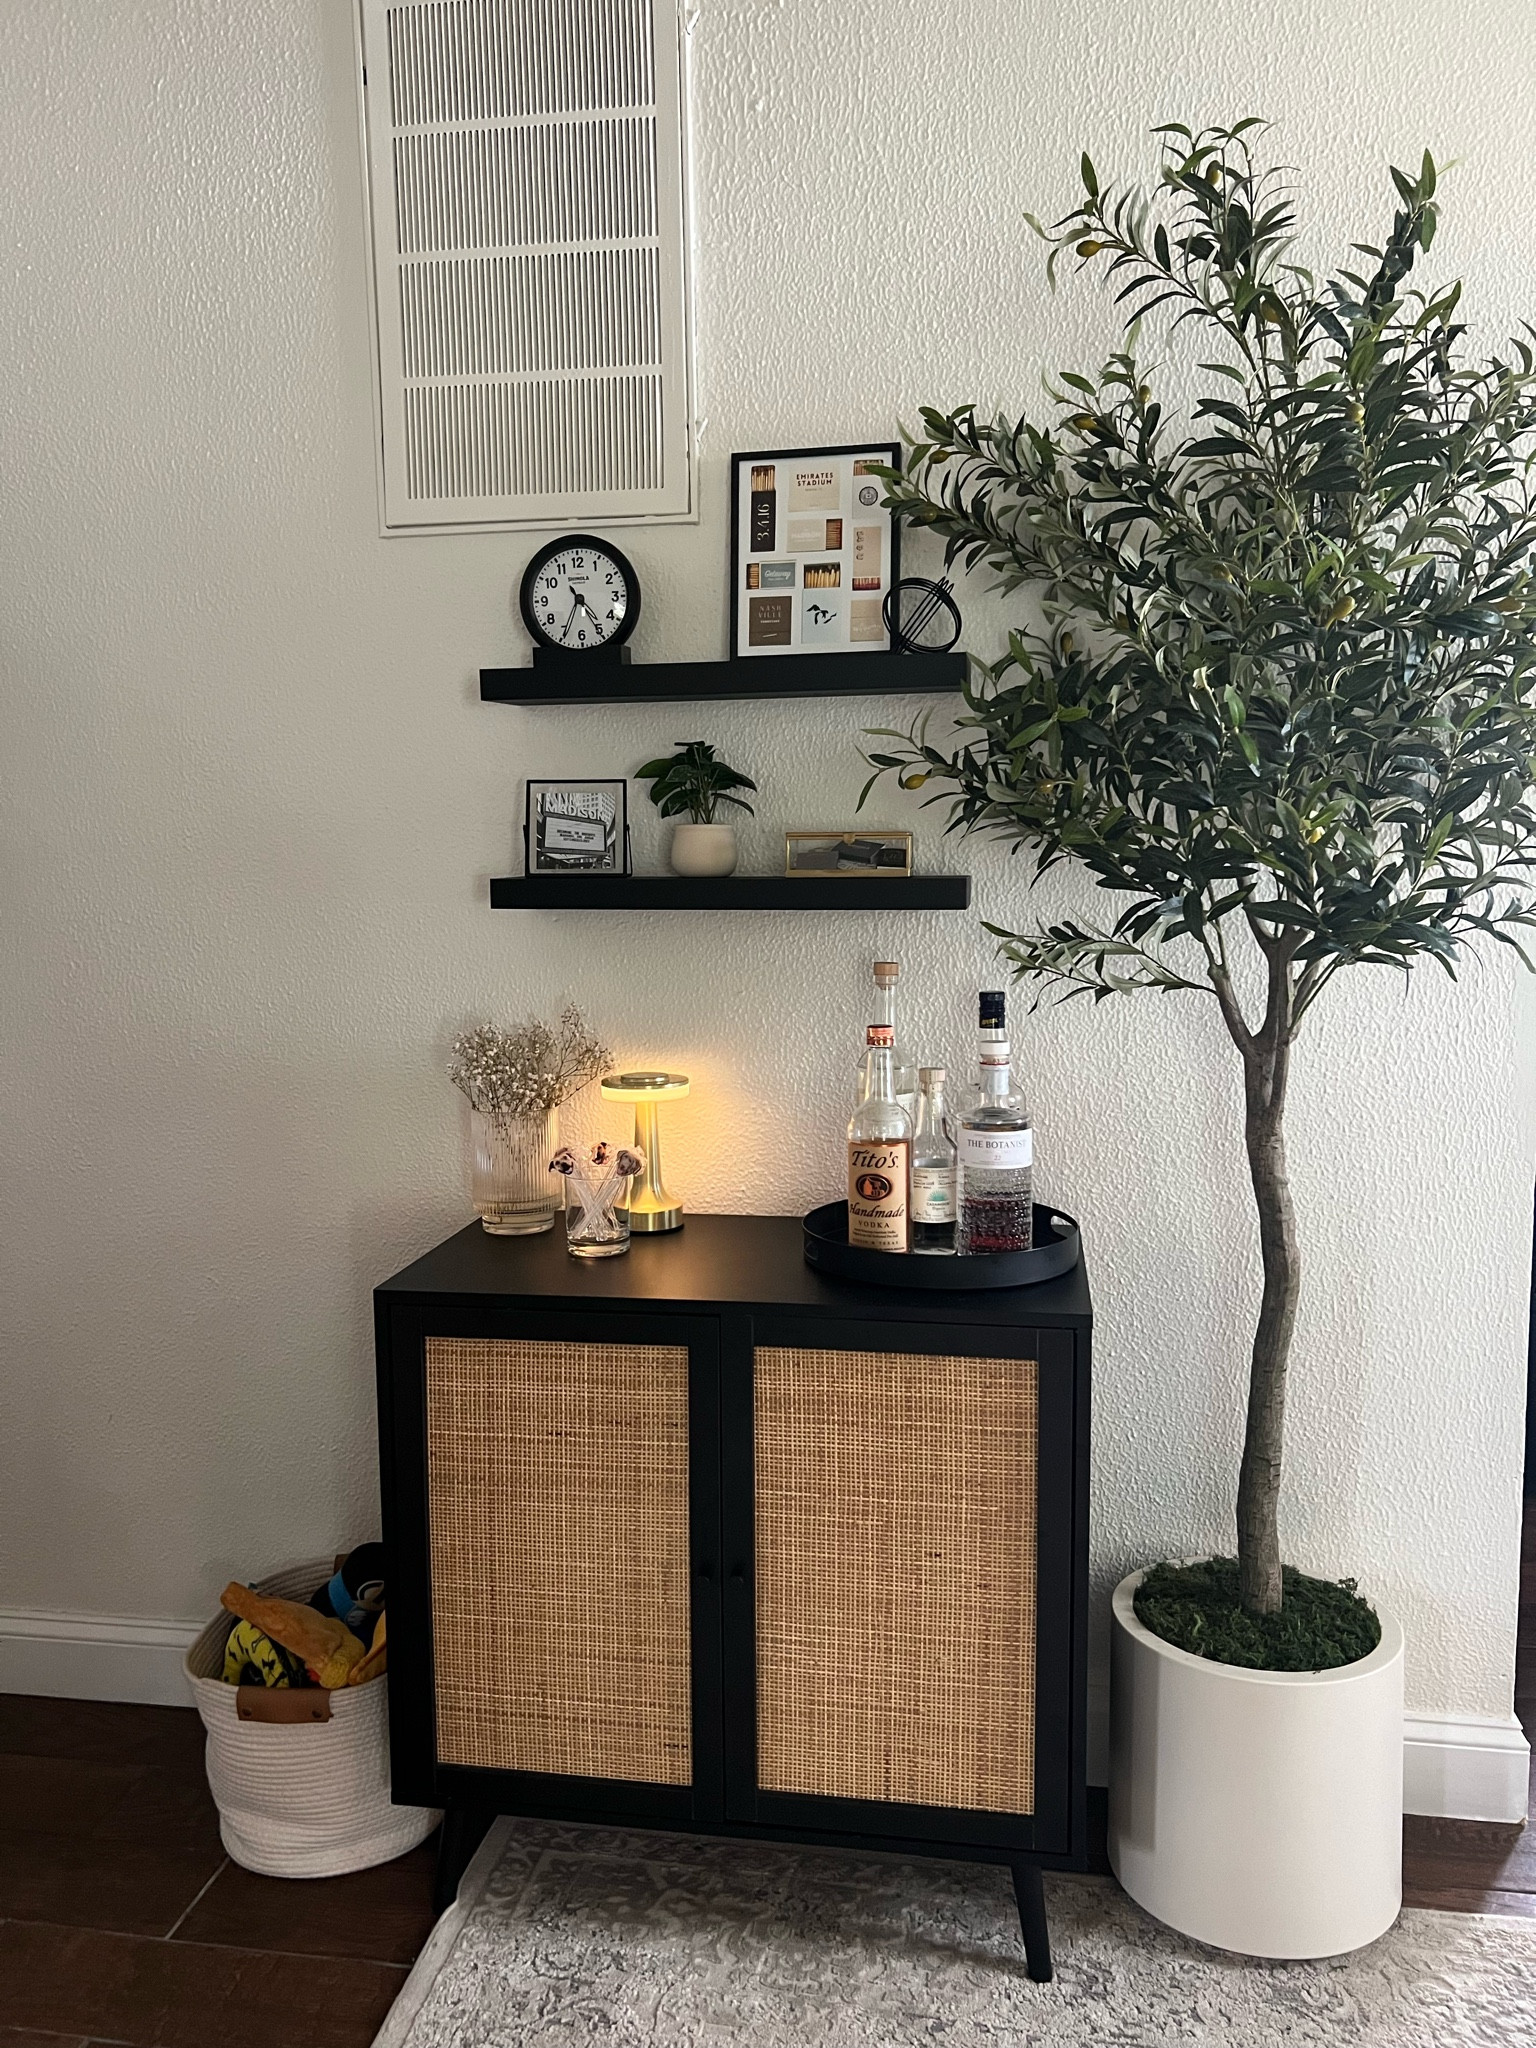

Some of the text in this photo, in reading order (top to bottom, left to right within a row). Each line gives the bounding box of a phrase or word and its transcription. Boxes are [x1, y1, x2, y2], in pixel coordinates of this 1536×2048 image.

[796, 472, 834, 480] EMIRATES
[797, 479, 832, 487] STADIUM
[556, 563, 566, 575] 11
[571, 557, 584, 569] 12
[593, 560, 598, 572] 1
[545, 577, 558, 589] 10
[605, 573, 613, 585] 2
[540, 596, 549, 607] 9
[611, 591, 620, 602] 3
[547, 613, 555, 625] 8
[606, 609, 615, 620] 4
[578, 629, 586, 641] 6
[595, 623, 603, 635] 5
[545, 803, 604, 820] MADISON
[967, 1139, 1027, 1149] THE BOTANIST
[849, 1202, 905, 1218] Handmade
[858, 1220, 890, 1229] VODKA
